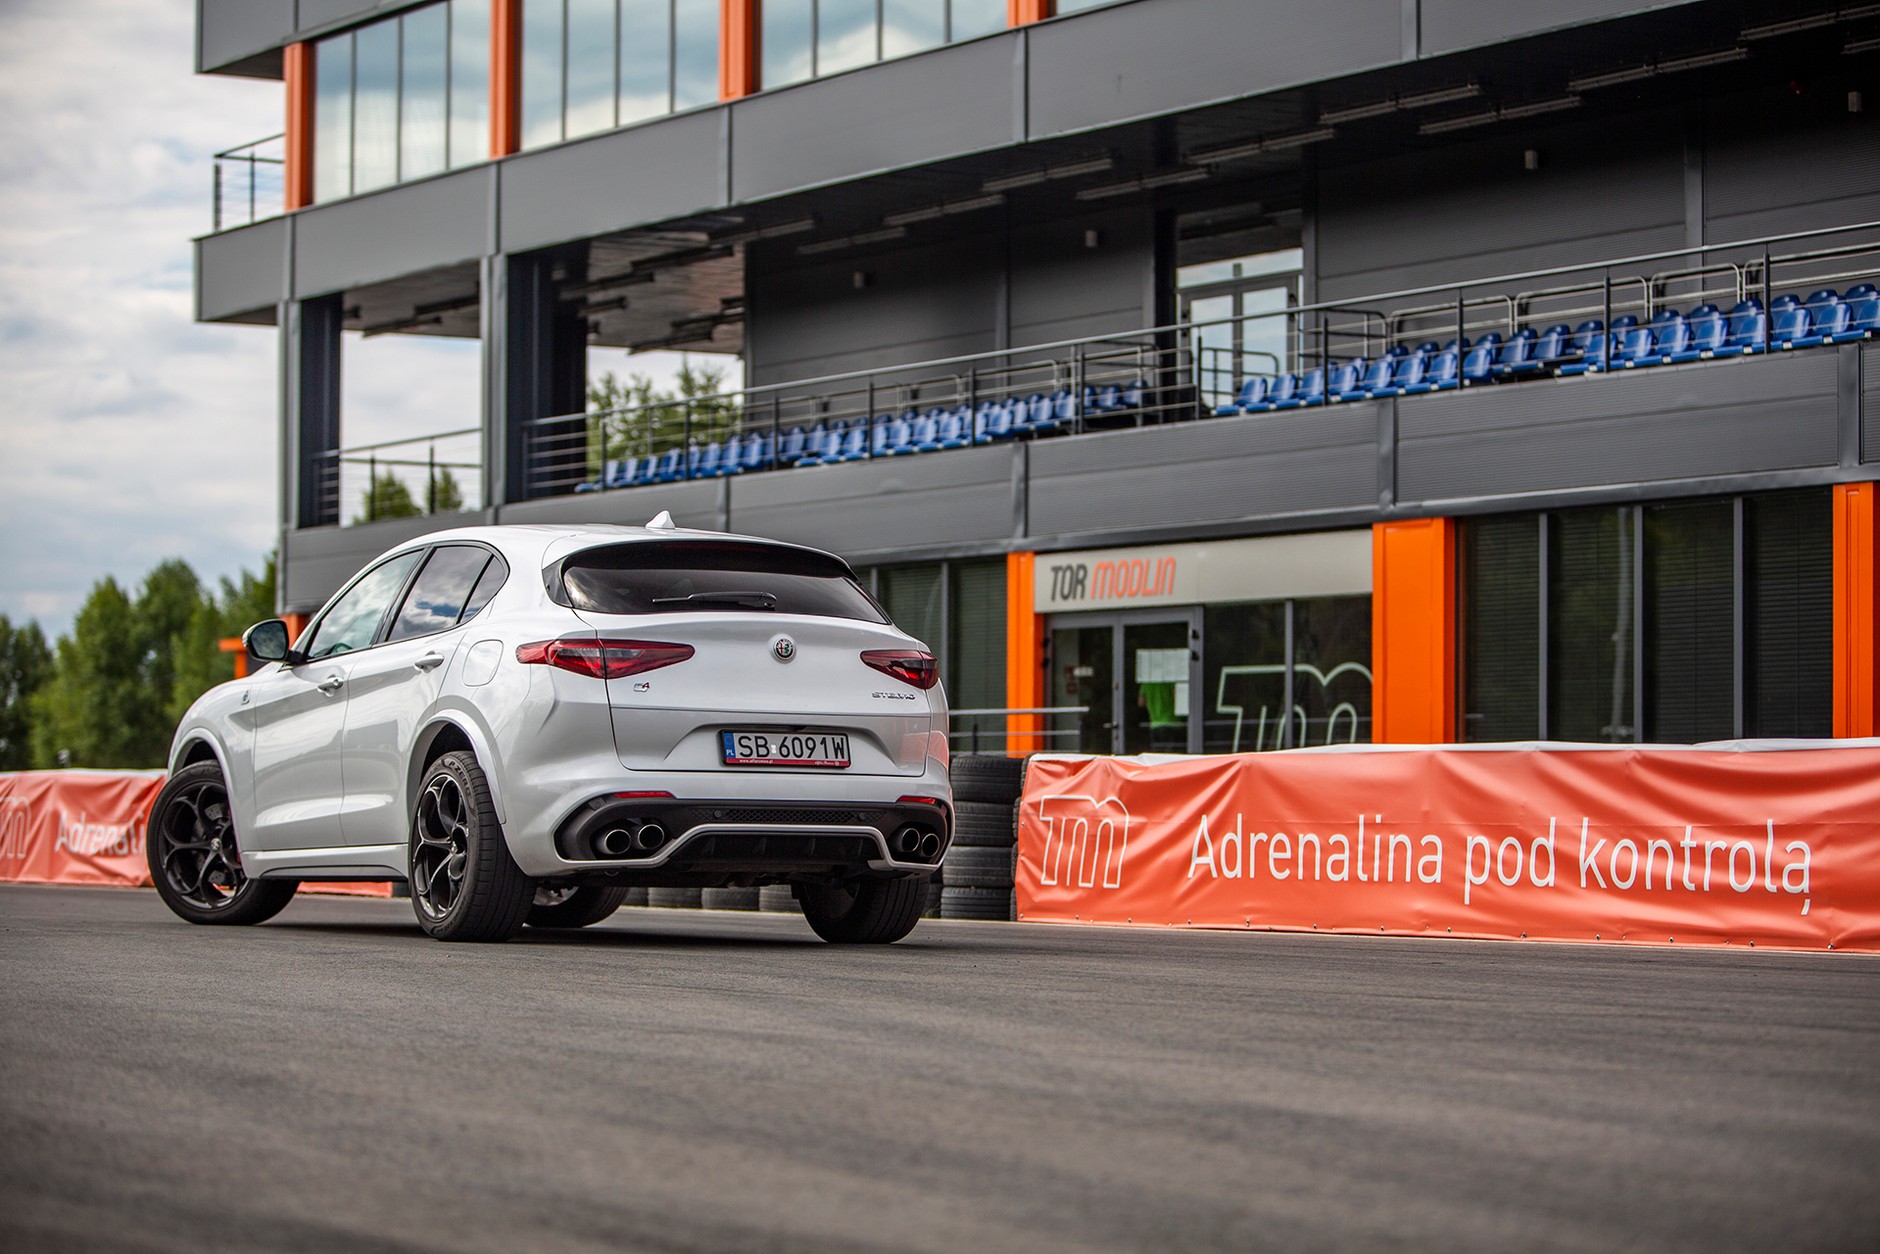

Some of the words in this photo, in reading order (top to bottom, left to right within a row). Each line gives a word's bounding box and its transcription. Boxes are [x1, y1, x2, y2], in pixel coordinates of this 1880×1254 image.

[1051, 563, 1088, 602] TOR
[1090, 556, 1176, 599] MODLIN
[871, 691, 916, 700] STELVIO
[738, 735, 770, 758] SB
[779, 736, 845, 759] 6091W
[1187, 813, 1443, 884] Adrenalina
[1464, 816, 1557, 905] pod
[1578, 816, 1811, 916] kontrolą
